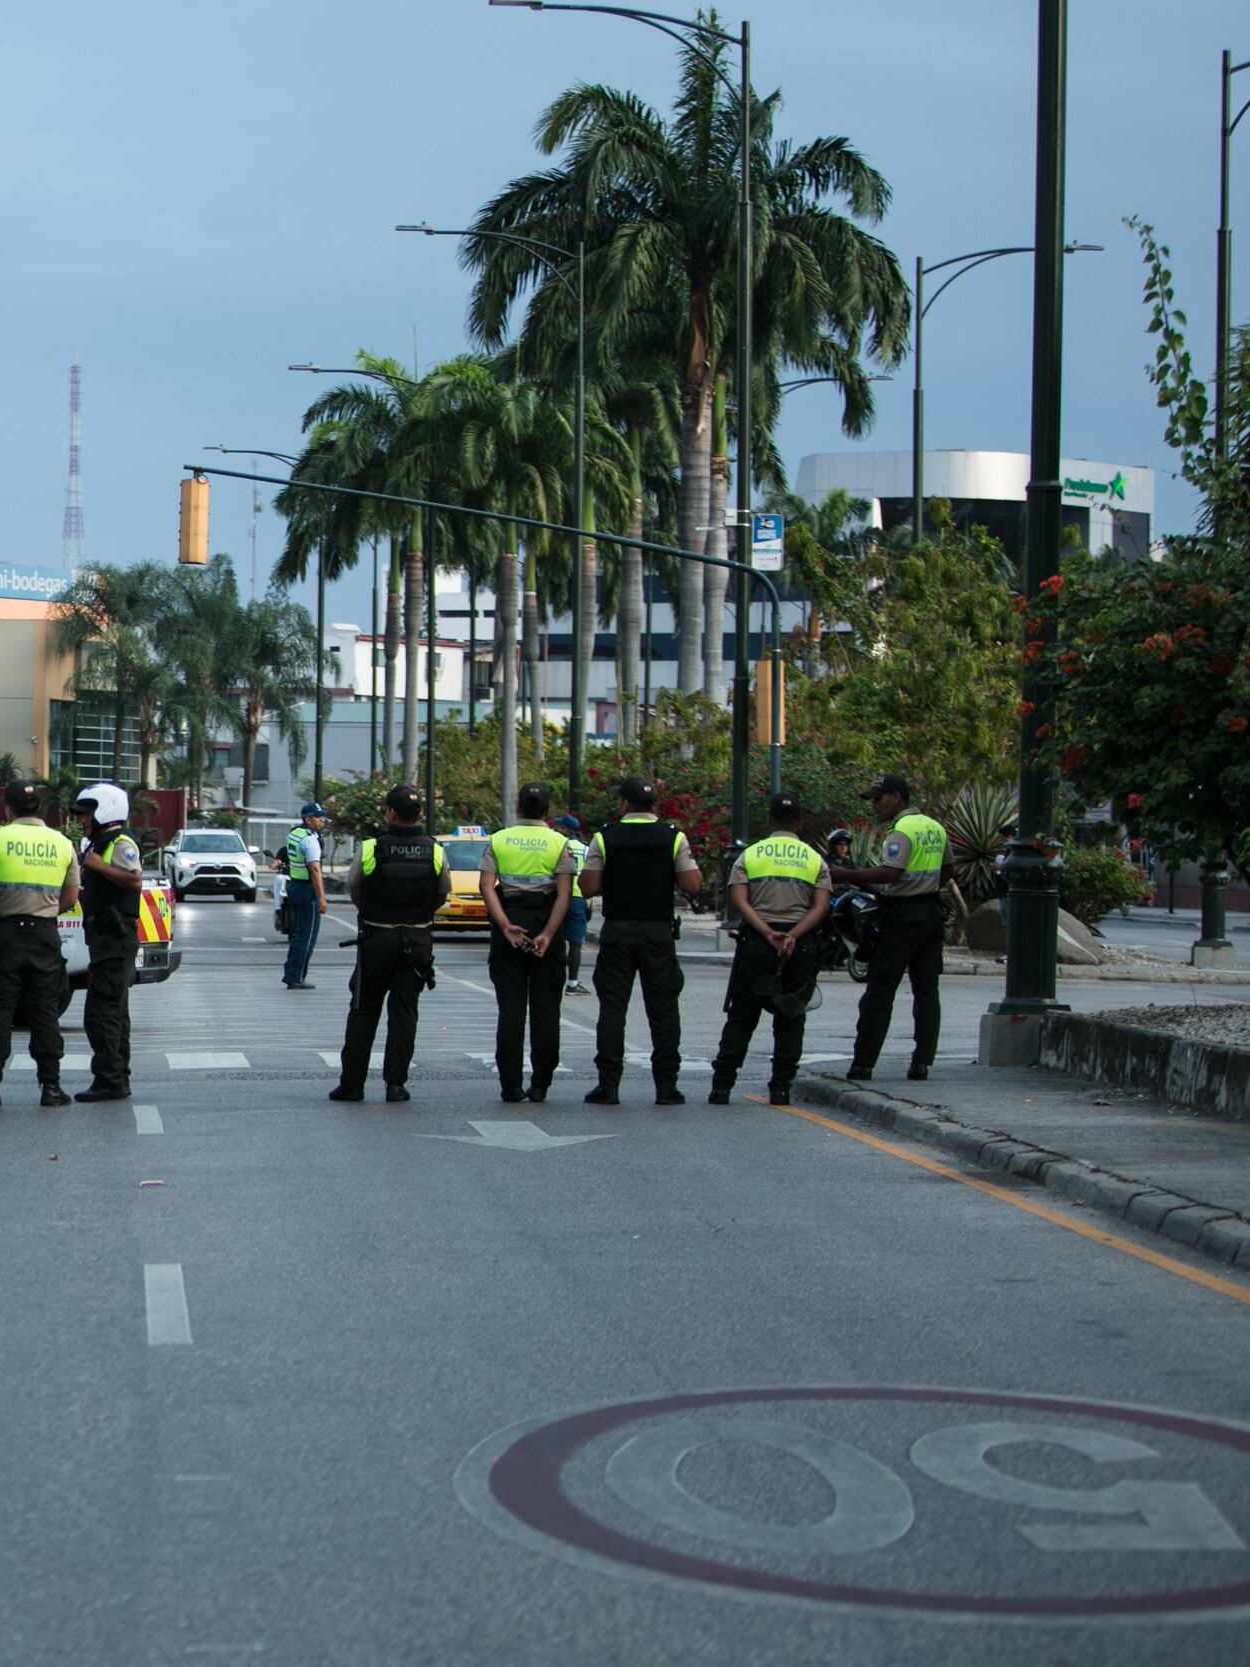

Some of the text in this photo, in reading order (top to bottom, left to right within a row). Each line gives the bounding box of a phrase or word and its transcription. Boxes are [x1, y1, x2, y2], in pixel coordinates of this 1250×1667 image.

[461, 827, 480, 835] TAXI
[6, 840, 58, 859] POLICÍA
[23, 858, 58, 868] NACIONAL
[773, 858, 809, 870] NACIONAL
[65, 920, 81, 929] 911
